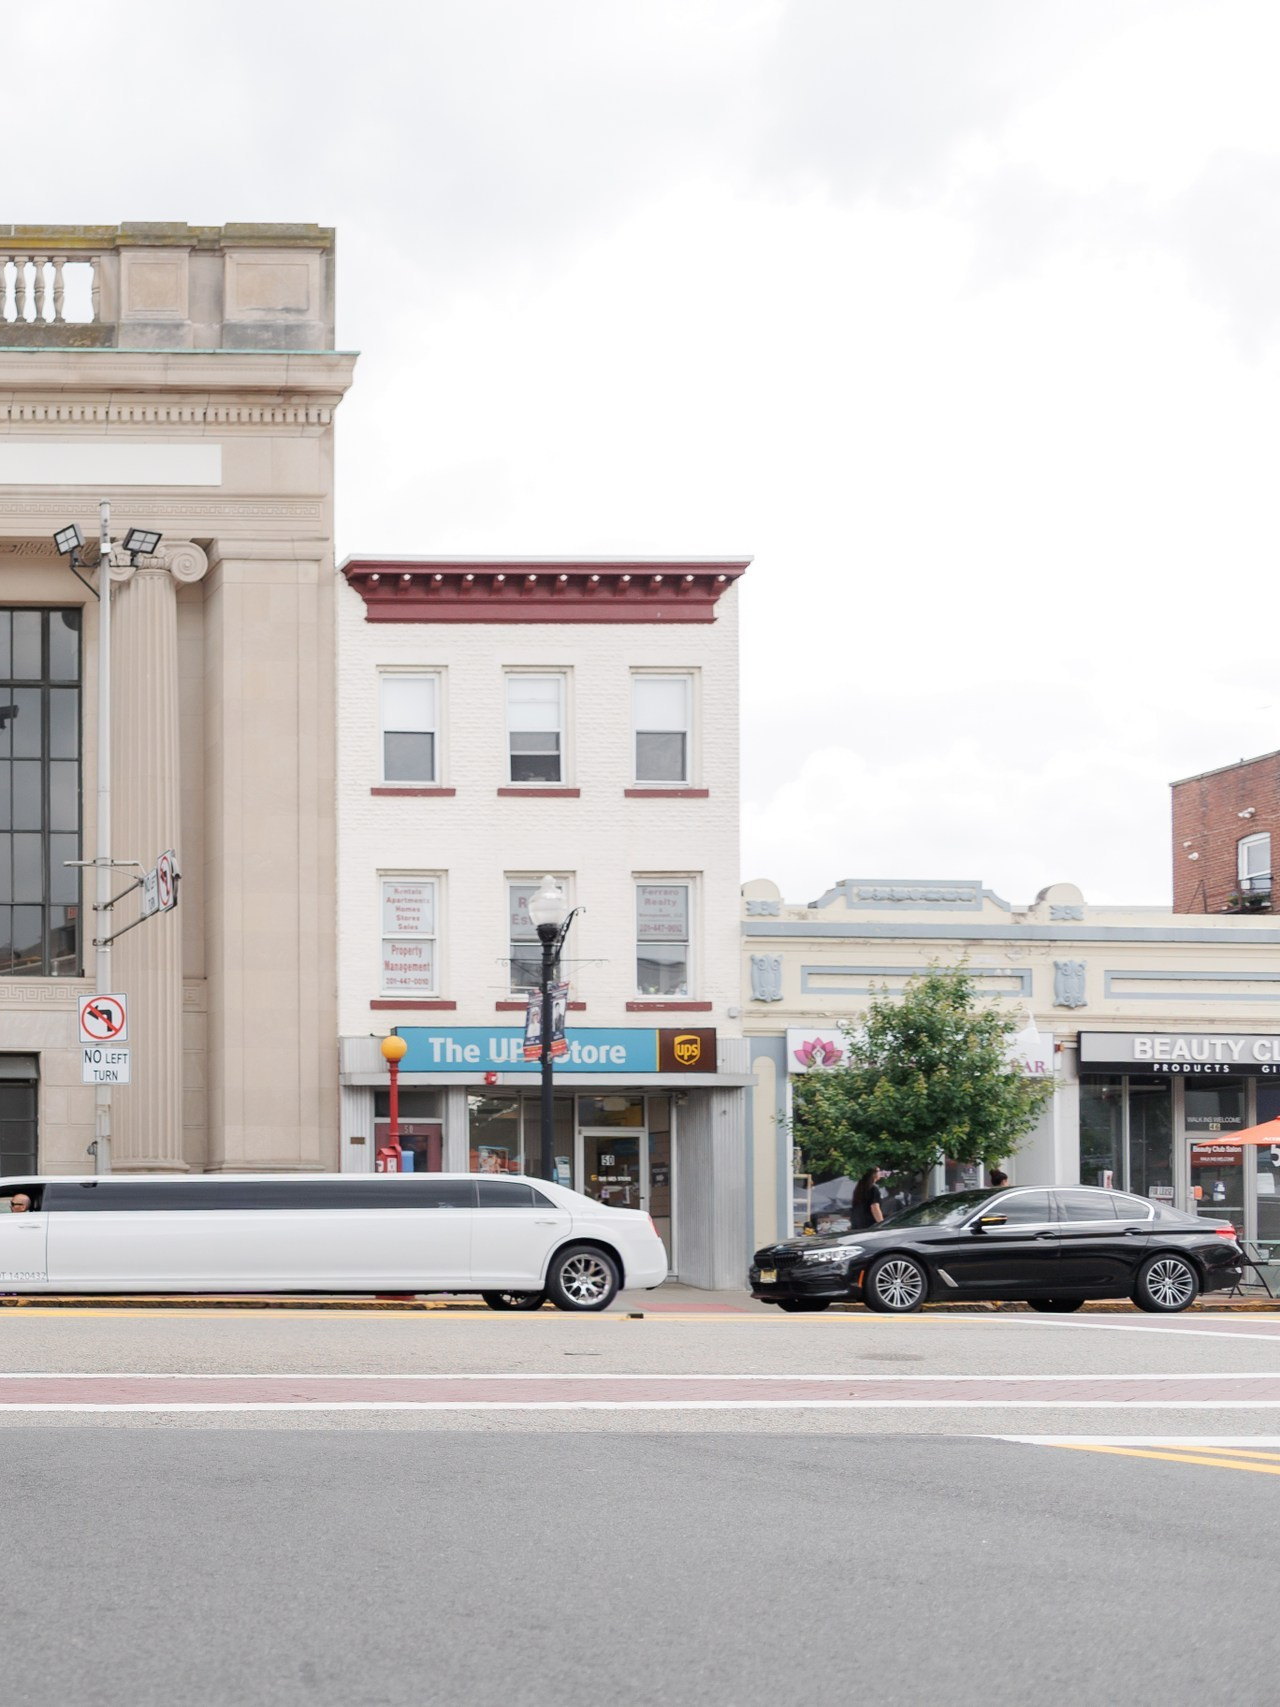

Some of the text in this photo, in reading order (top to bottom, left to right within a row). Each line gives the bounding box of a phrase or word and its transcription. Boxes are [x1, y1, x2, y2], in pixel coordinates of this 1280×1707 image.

[644, 898, 677, 907] Realty
[395, 914, 421, 922] Stores
[391, 944, 422, 958] Property
[383, 960, 431, 973] Management
[428, 1037, 481, 1063] The
[489, 1038, 534, 1063] UP
[677, 1044, 698, 1060] ups
[1133, 1038, 1246, 1061] BEAUTY
[84, 1049, 128, 1064] NO LEFT
[1153, 1063, 1280, 1074] PRODUCTS GI
[93, 1069, 118, 1081] TURN
[1213, 1116, 1241, 1124] WELCOME
[1192, 1145, 1242, 1154] Beauty Club Salon
[602, 1155, 614, 1165] 50
[9, 1272, 47, 1280] 1420432
